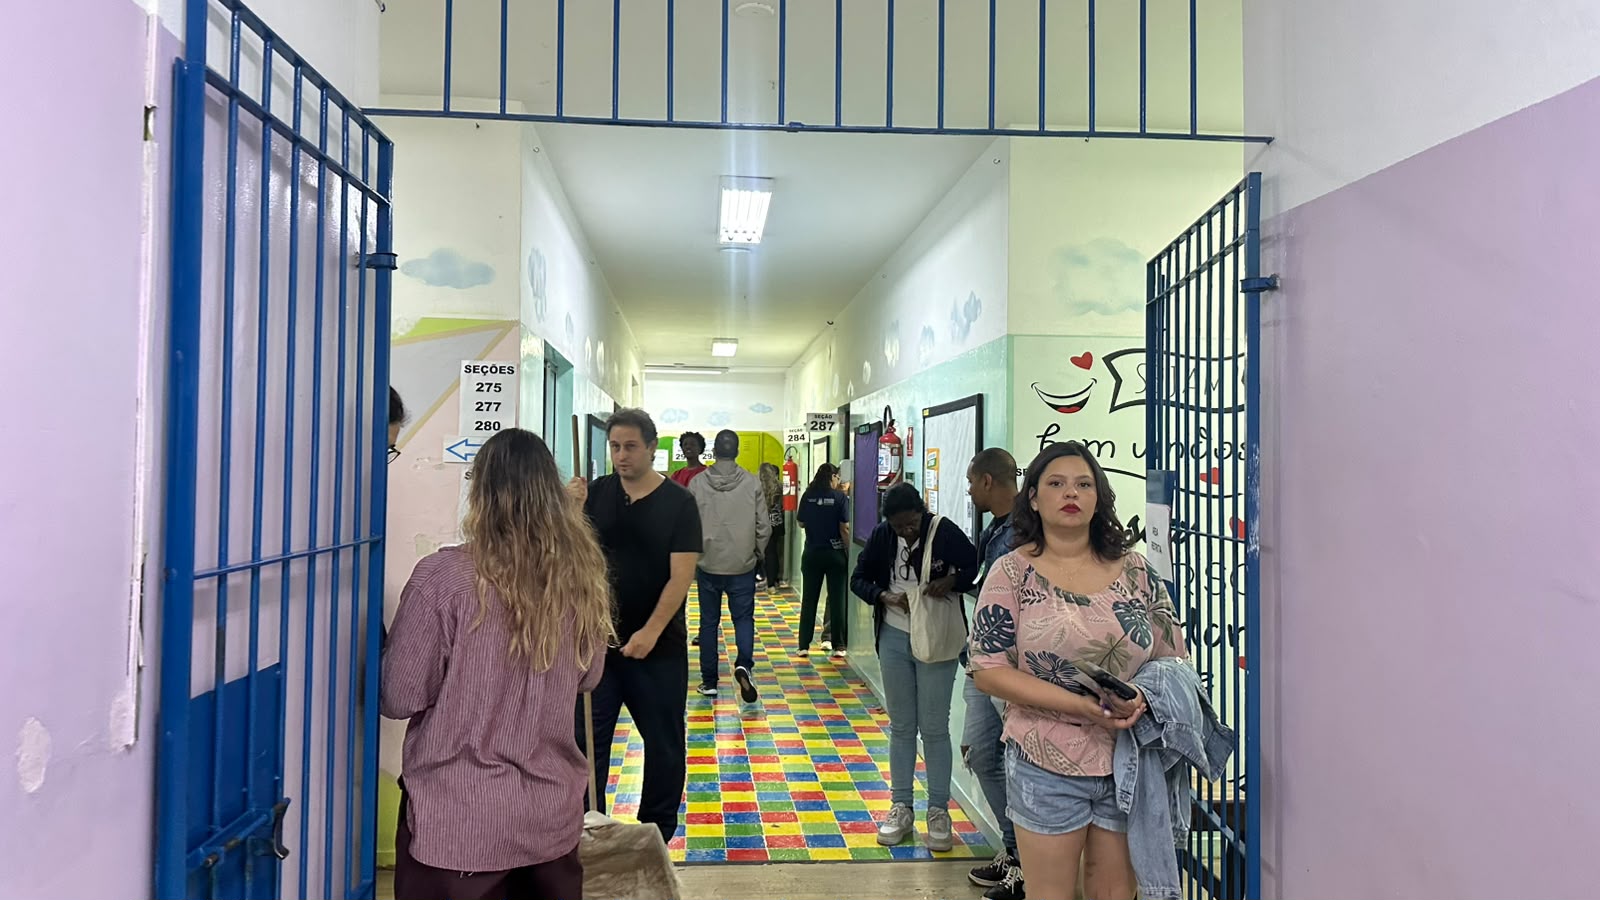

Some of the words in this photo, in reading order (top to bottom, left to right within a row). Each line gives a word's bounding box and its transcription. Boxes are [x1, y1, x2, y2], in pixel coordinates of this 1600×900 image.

[464, 364, 515, 376] SEÇÕES
[476, 382, 502, 392] 275
[475, 402, 502, 412] 277
[474, 420, 501, 431] 280
[810, 420, 835, 431] 287
[788, 434, 806, 442] 284
